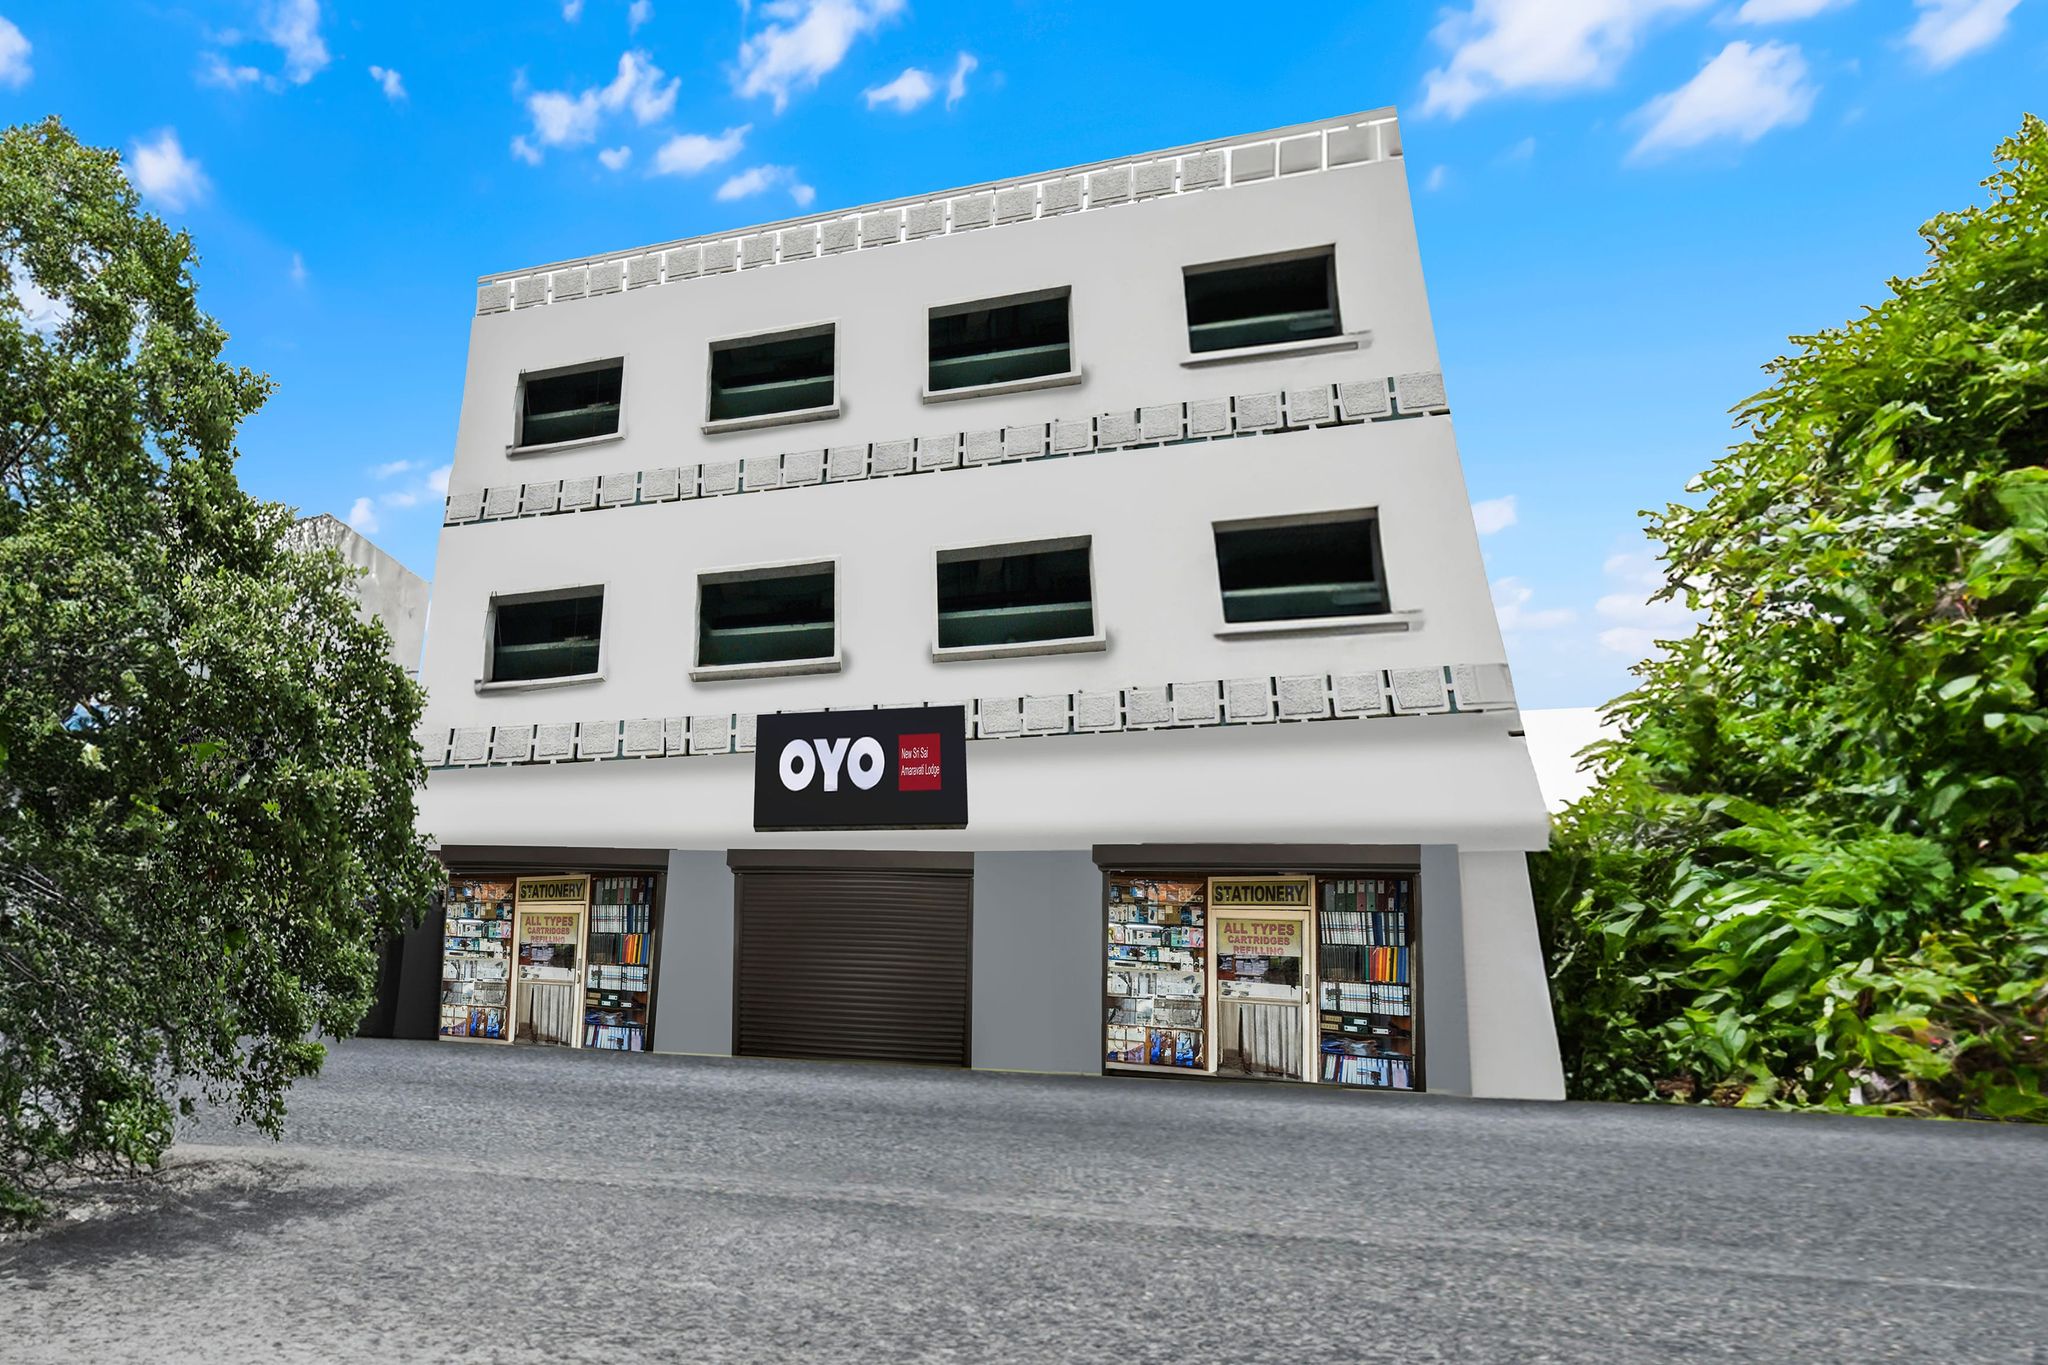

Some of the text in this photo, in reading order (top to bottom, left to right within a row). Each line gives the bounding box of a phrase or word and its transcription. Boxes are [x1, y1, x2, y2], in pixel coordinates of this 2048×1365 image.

[901, 746, 929, 759] New Sri Sai
[779, 736, 885, 791] OYO
[901, 763, 940, 777] Amaravati Lodge
[520, 884, 582, 898] STATIONERY
[1215, 885, 1305, 902] STATIONERY
[525, 916, 574, 927] ALL TYPES
[527, 927, 570, 935] CARTRIDGES
[1224, 922, 1295, 936] ALL TYPES
[1227, 935, 1291, 946] CARTRIDGES
[1233, 945, 1284, 955] REFILLING
